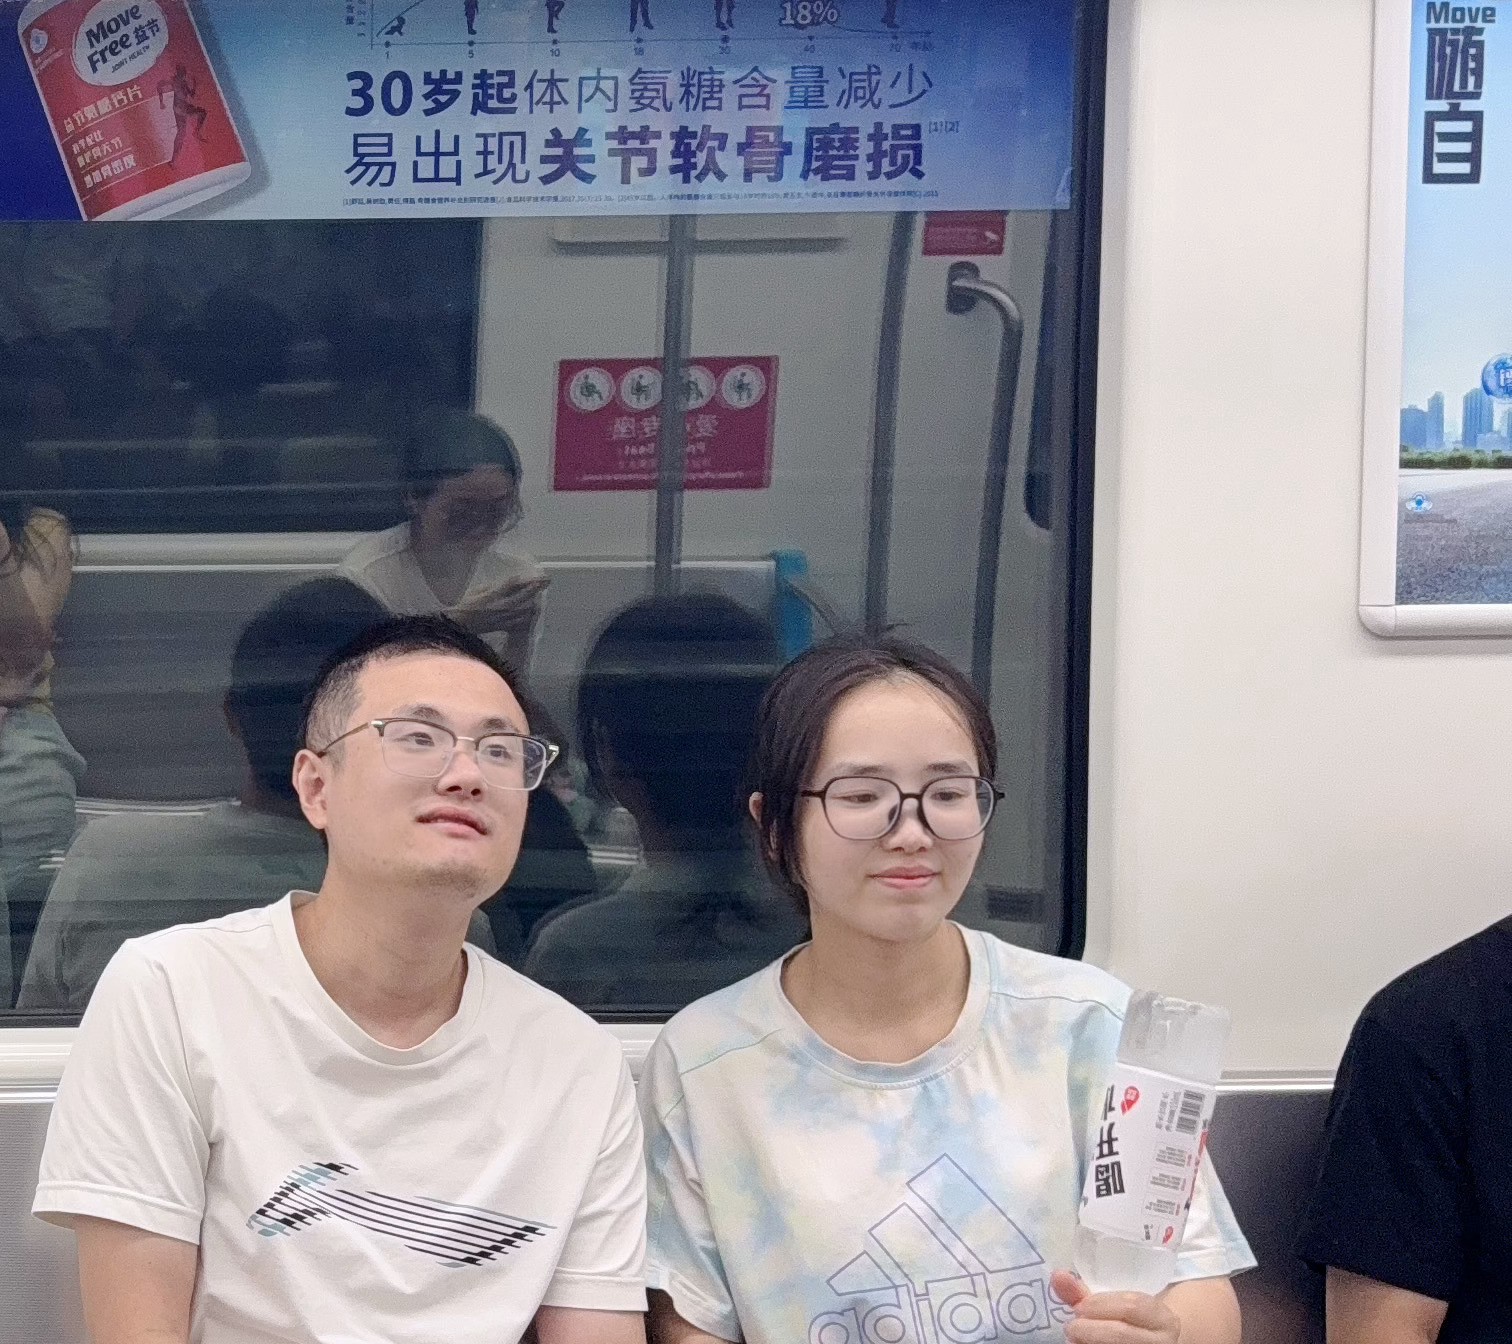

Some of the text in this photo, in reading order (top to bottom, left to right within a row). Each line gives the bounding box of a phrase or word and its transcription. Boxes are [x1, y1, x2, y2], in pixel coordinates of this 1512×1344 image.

[85, 4, 143, 48] Move
[780, 0, 839, 27] 18%
[1425, 1, 1497, 25] Move
[88, 32, 132, 75] Free
[344, 65, 934, 118] 30岁起体内氨糖含量减少
[344, 122, 926, 188] 易出现关节软骨磨损
[1421, 102, 1485, 184] 自
